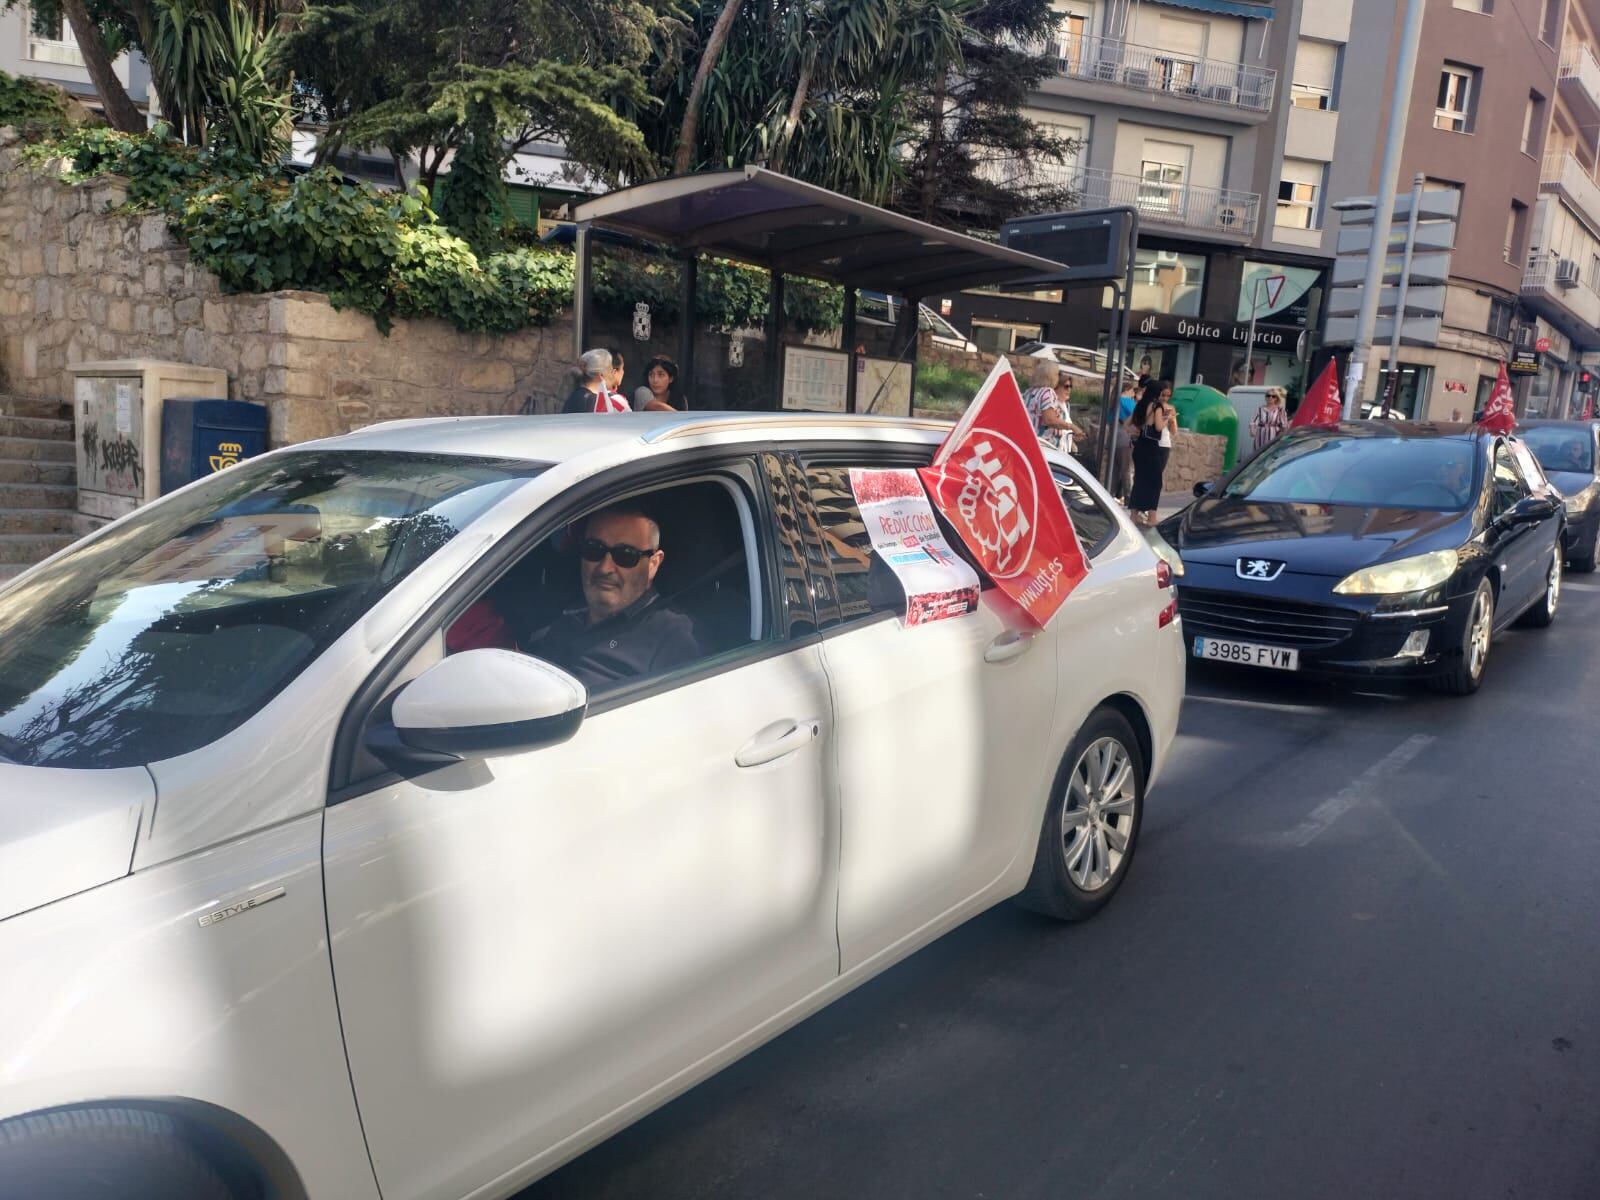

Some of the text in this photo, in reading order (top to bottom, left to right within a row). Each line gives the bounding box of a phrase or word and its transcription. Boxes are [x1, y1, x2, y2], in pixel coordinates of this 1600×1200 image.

[1178, 319, 1220, 339] Óptica
[1232, 327, 1282, 345] Lijarcio
[878, 511, 936, 536] REDUCCIÓN
[1017, 556, 1064, 610] www.ugt.es
[1209, 641, 1292, 668] 3985 FVW
[213, 899, 257, 921] STYLE
